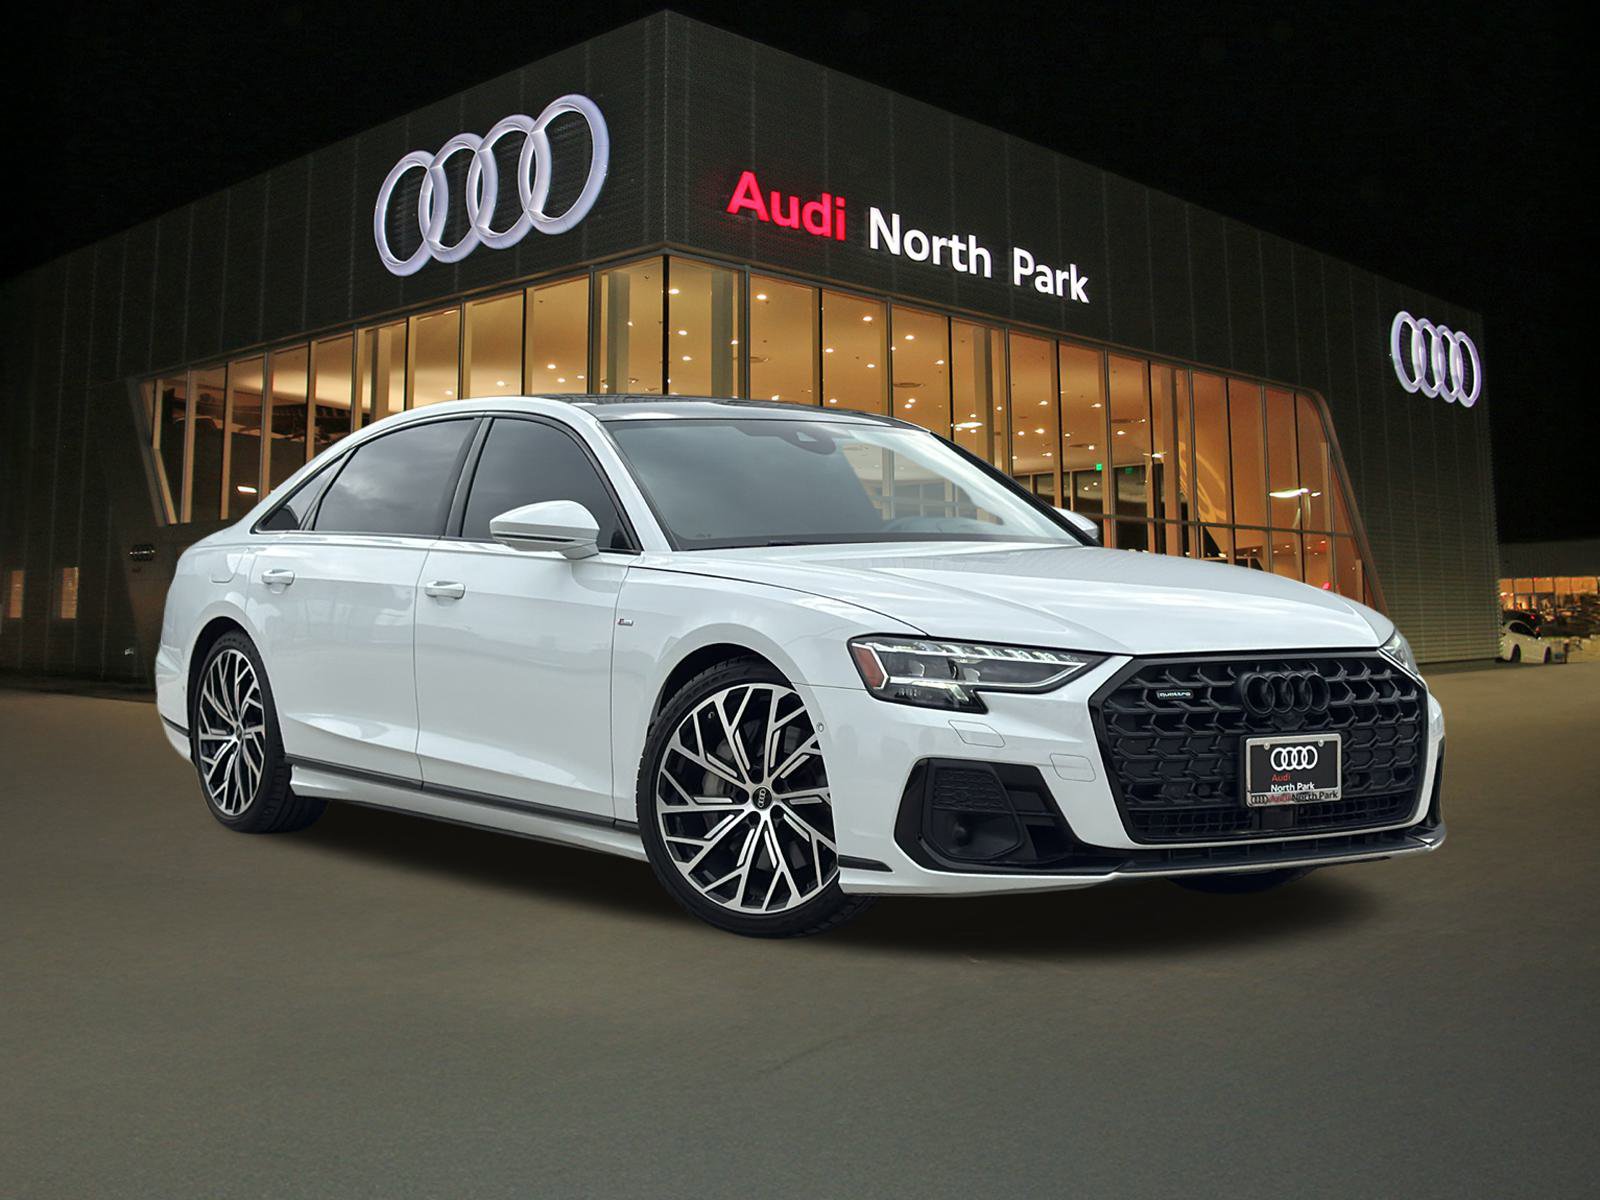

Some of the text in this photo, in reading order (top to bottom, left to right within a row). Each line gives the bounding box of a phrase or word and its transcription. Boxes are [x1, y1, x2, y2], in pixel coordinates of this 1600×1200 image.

[727, 171, 1090, 303] Audi North Park
[1272, 774, 1291, 782] Audi
[1271, 782, 1314, 792] North Park
[1292, 792, 1317, 802] North
[1319, 791, 1338, 800] Park
